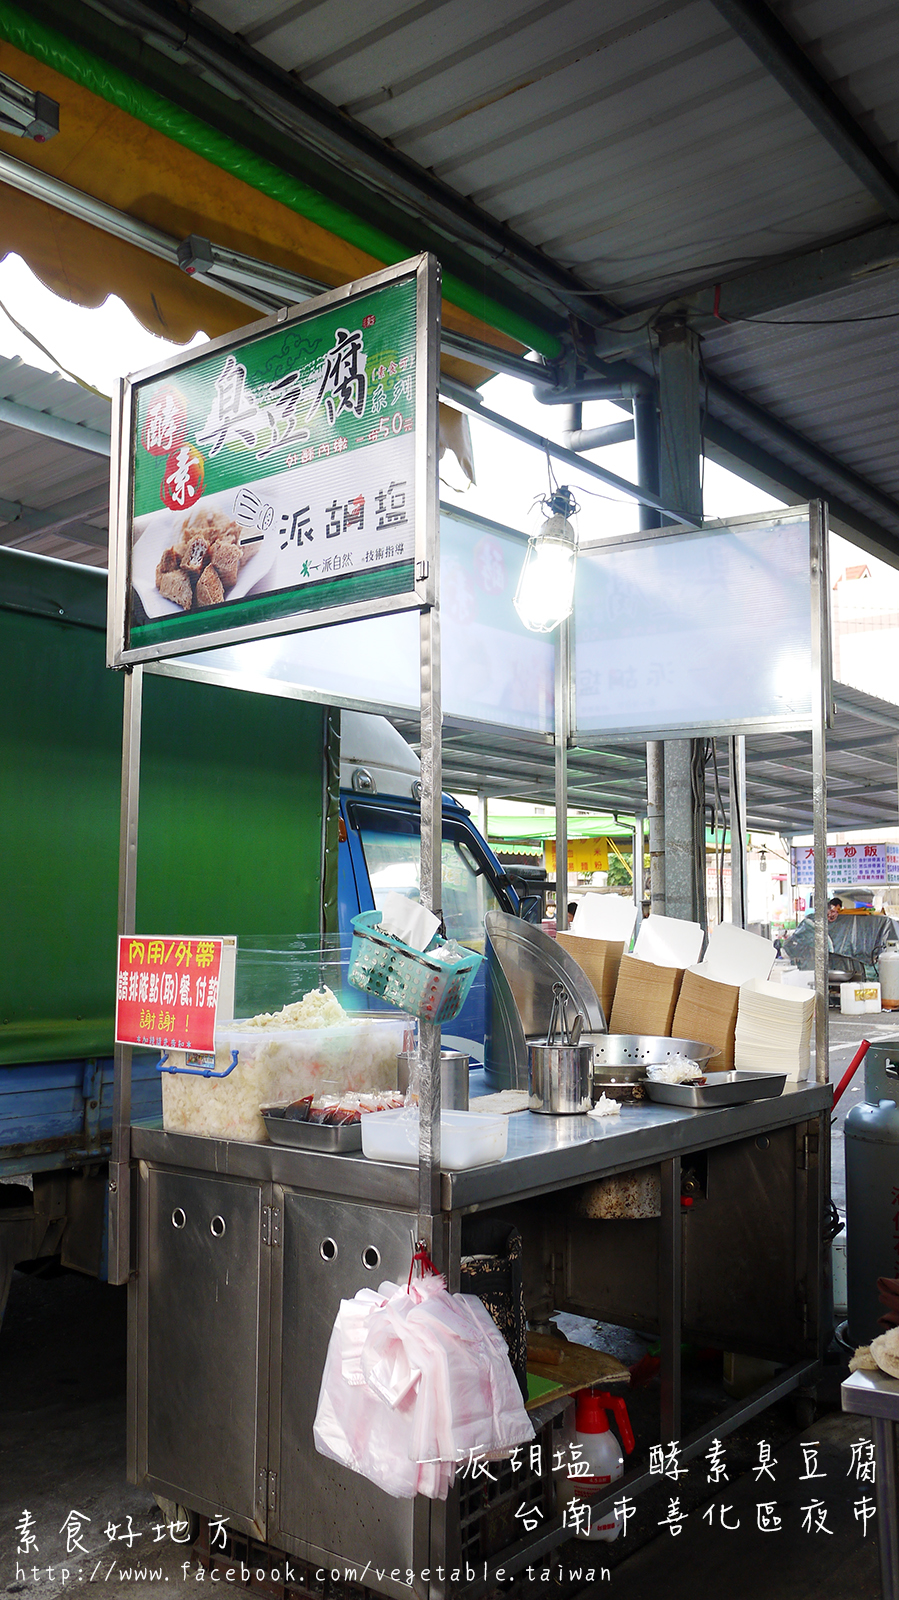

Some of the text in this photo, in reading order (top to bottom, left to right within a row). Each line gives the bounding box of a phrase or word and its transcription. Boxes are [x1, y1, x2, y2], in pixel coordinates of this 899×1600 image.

[195, 328, 367, 460] 臭豆腐
[371, 375, 412, 414] 系列
